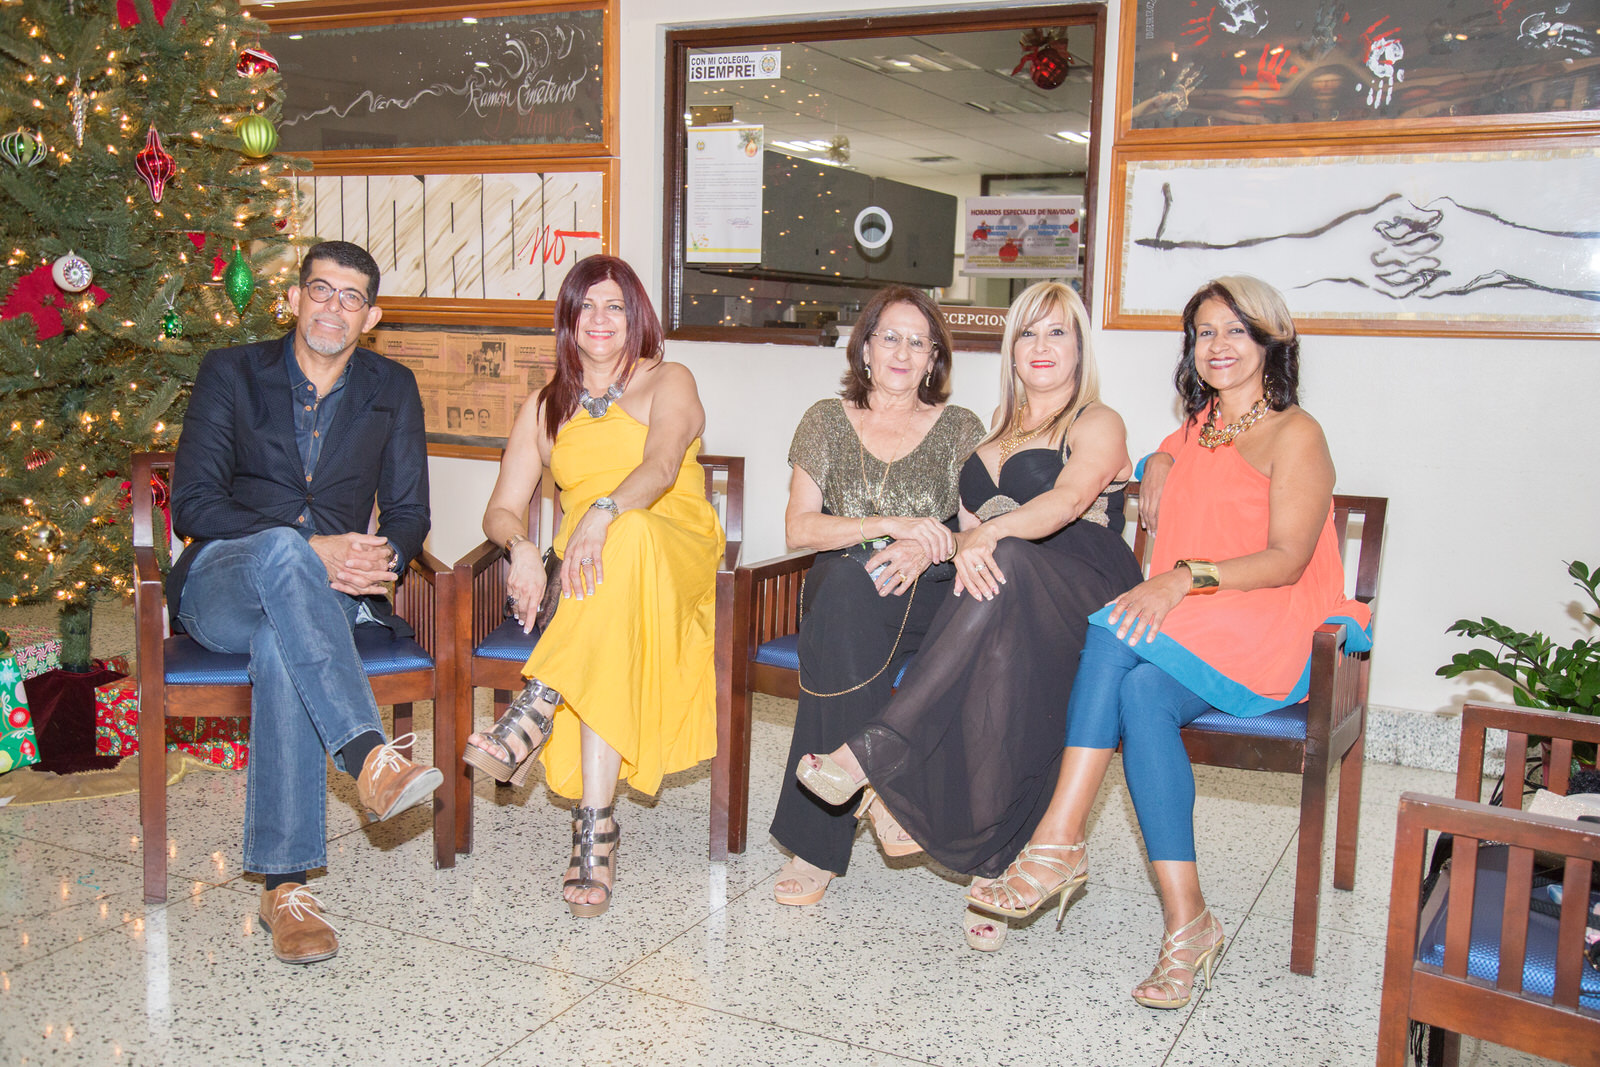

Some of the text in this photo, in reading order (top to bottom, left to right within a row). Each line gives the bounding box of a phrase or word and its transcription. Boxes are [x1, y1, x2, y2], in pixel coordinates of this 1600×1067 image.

[691, 57, 706, 66] CON
[708, 56, 716, 65] MI
[691, 64, 756, 79] ¡SIEMPRE!
[971, 208, 1002, 216] HORARIOS
[1003, 208, 1037, 216] ESPECIALES
[1037, 208, 1046, 216] DE
